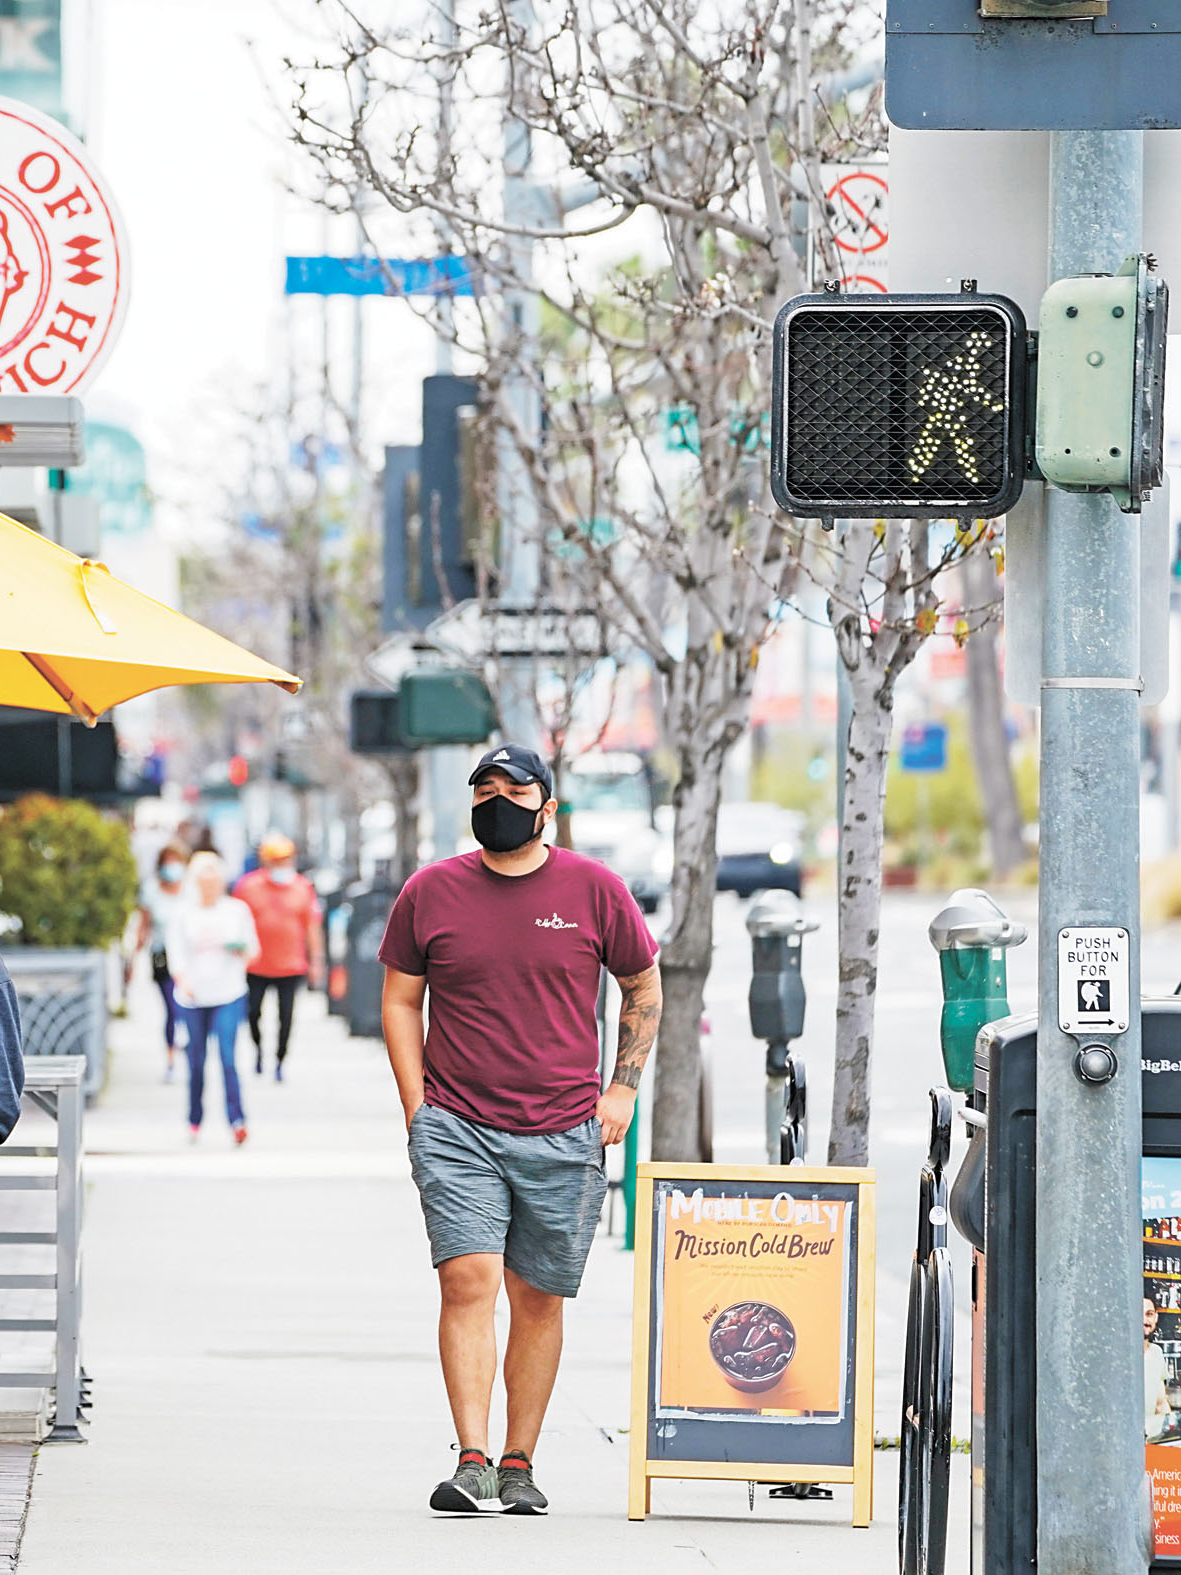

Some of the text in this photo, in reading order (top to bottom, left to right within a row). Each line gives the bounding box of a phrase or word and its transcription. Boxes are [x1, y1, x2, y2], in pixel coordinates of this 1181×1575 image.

[19, 151, 93, 219] OF
[1075, 937, 1111, 949] PUSH
[1067, 951, 1119, 963] BUTTON
[1080, 965, 1107, 976] FOR
[674, 1229, 835, 1260] Mission Cold Brew
